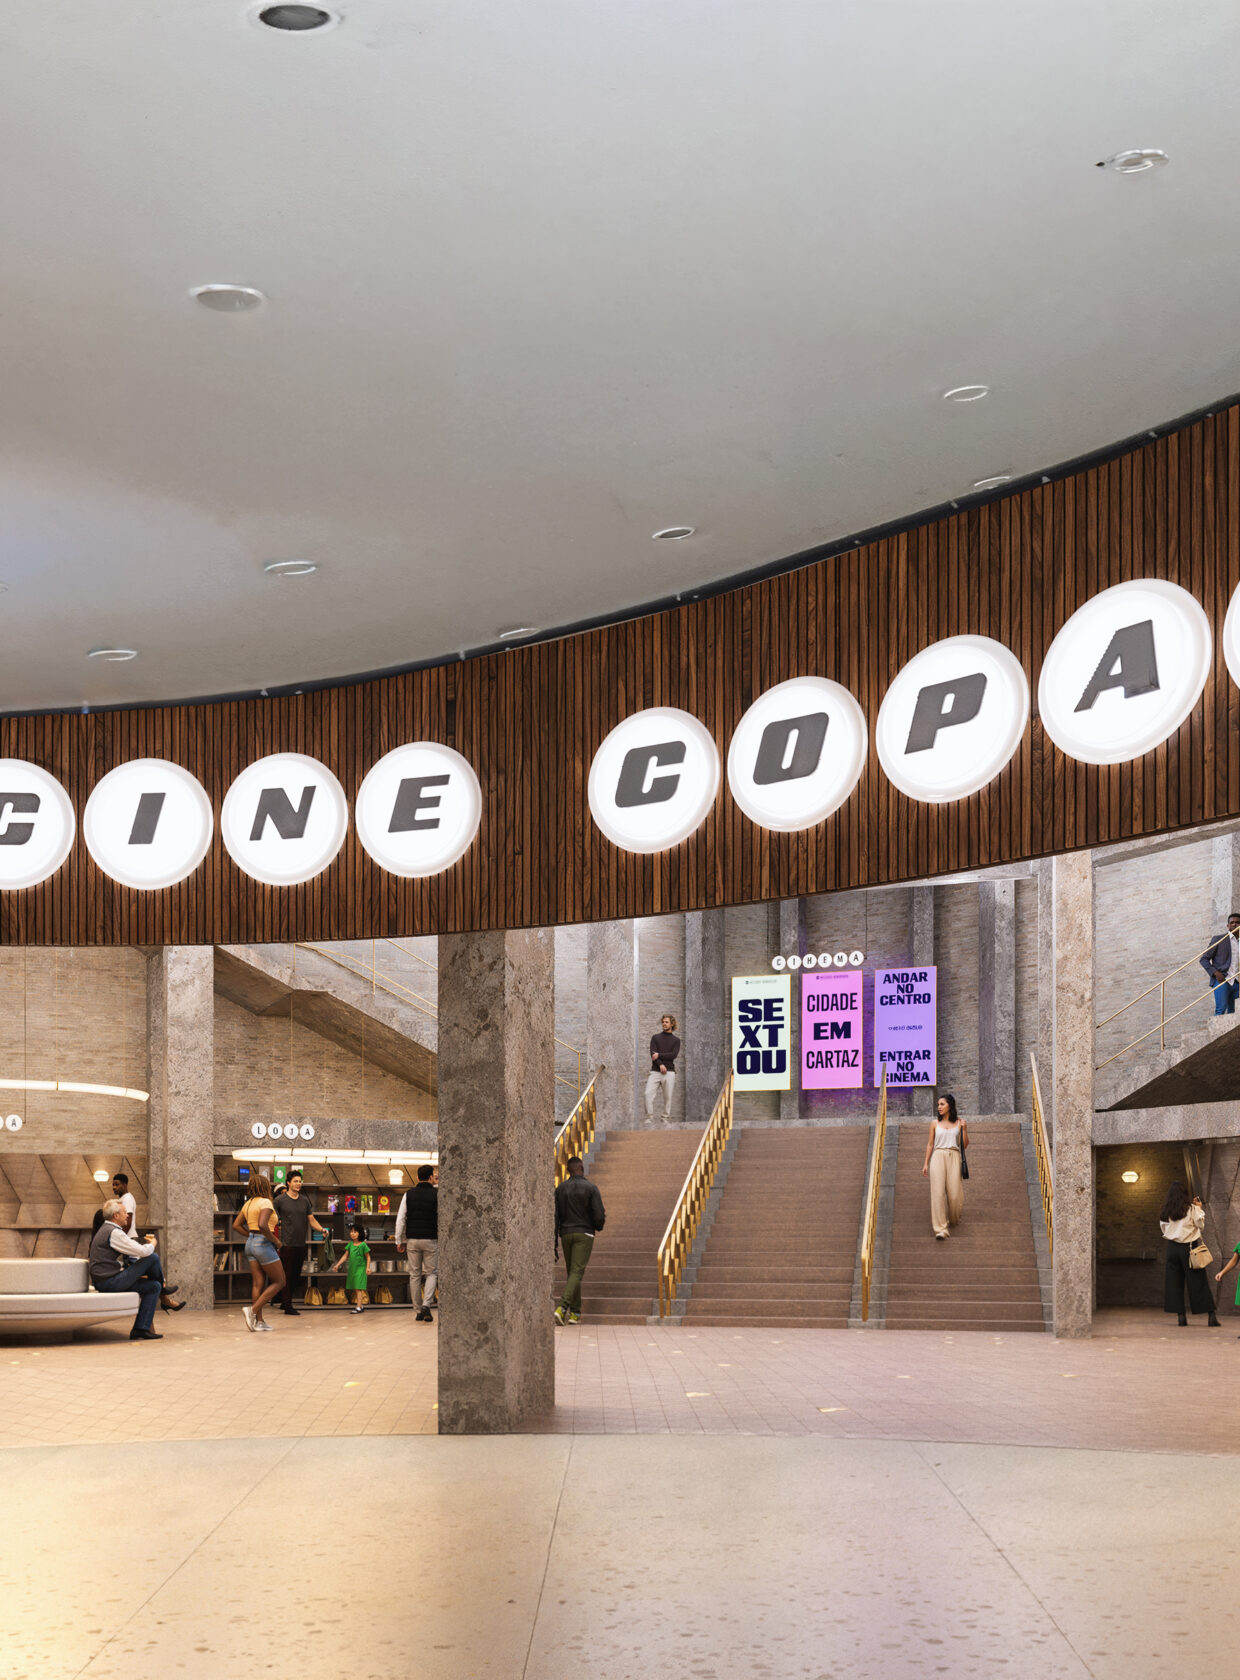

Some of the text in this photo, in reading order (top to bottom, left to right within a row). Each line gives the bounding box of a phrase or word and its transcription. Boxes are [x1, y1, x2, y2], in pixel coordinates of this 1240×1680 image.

[0, 619, 1161, 845] CINE COPA
[883, 971, 928, 985] ANDAR
[896, 983, 914, 994] NO
[806, 992, 858, 1012] CIDADE
[880, 993, 931, 1006] CENTRO
[738, 998, 785, 1023] SE
[738, 1024, 785, 1049] XT
[813, 1021, 851, 1040] EM
[736, 1049, 787, 1075] OU
[806, 1049, 859, 1069] CARTAZ
[880, 1049, 931, 1062] ENTRAR
[896, 1061, 915, 1072] NO
[256, 1125, 312, 1136] LOJA
